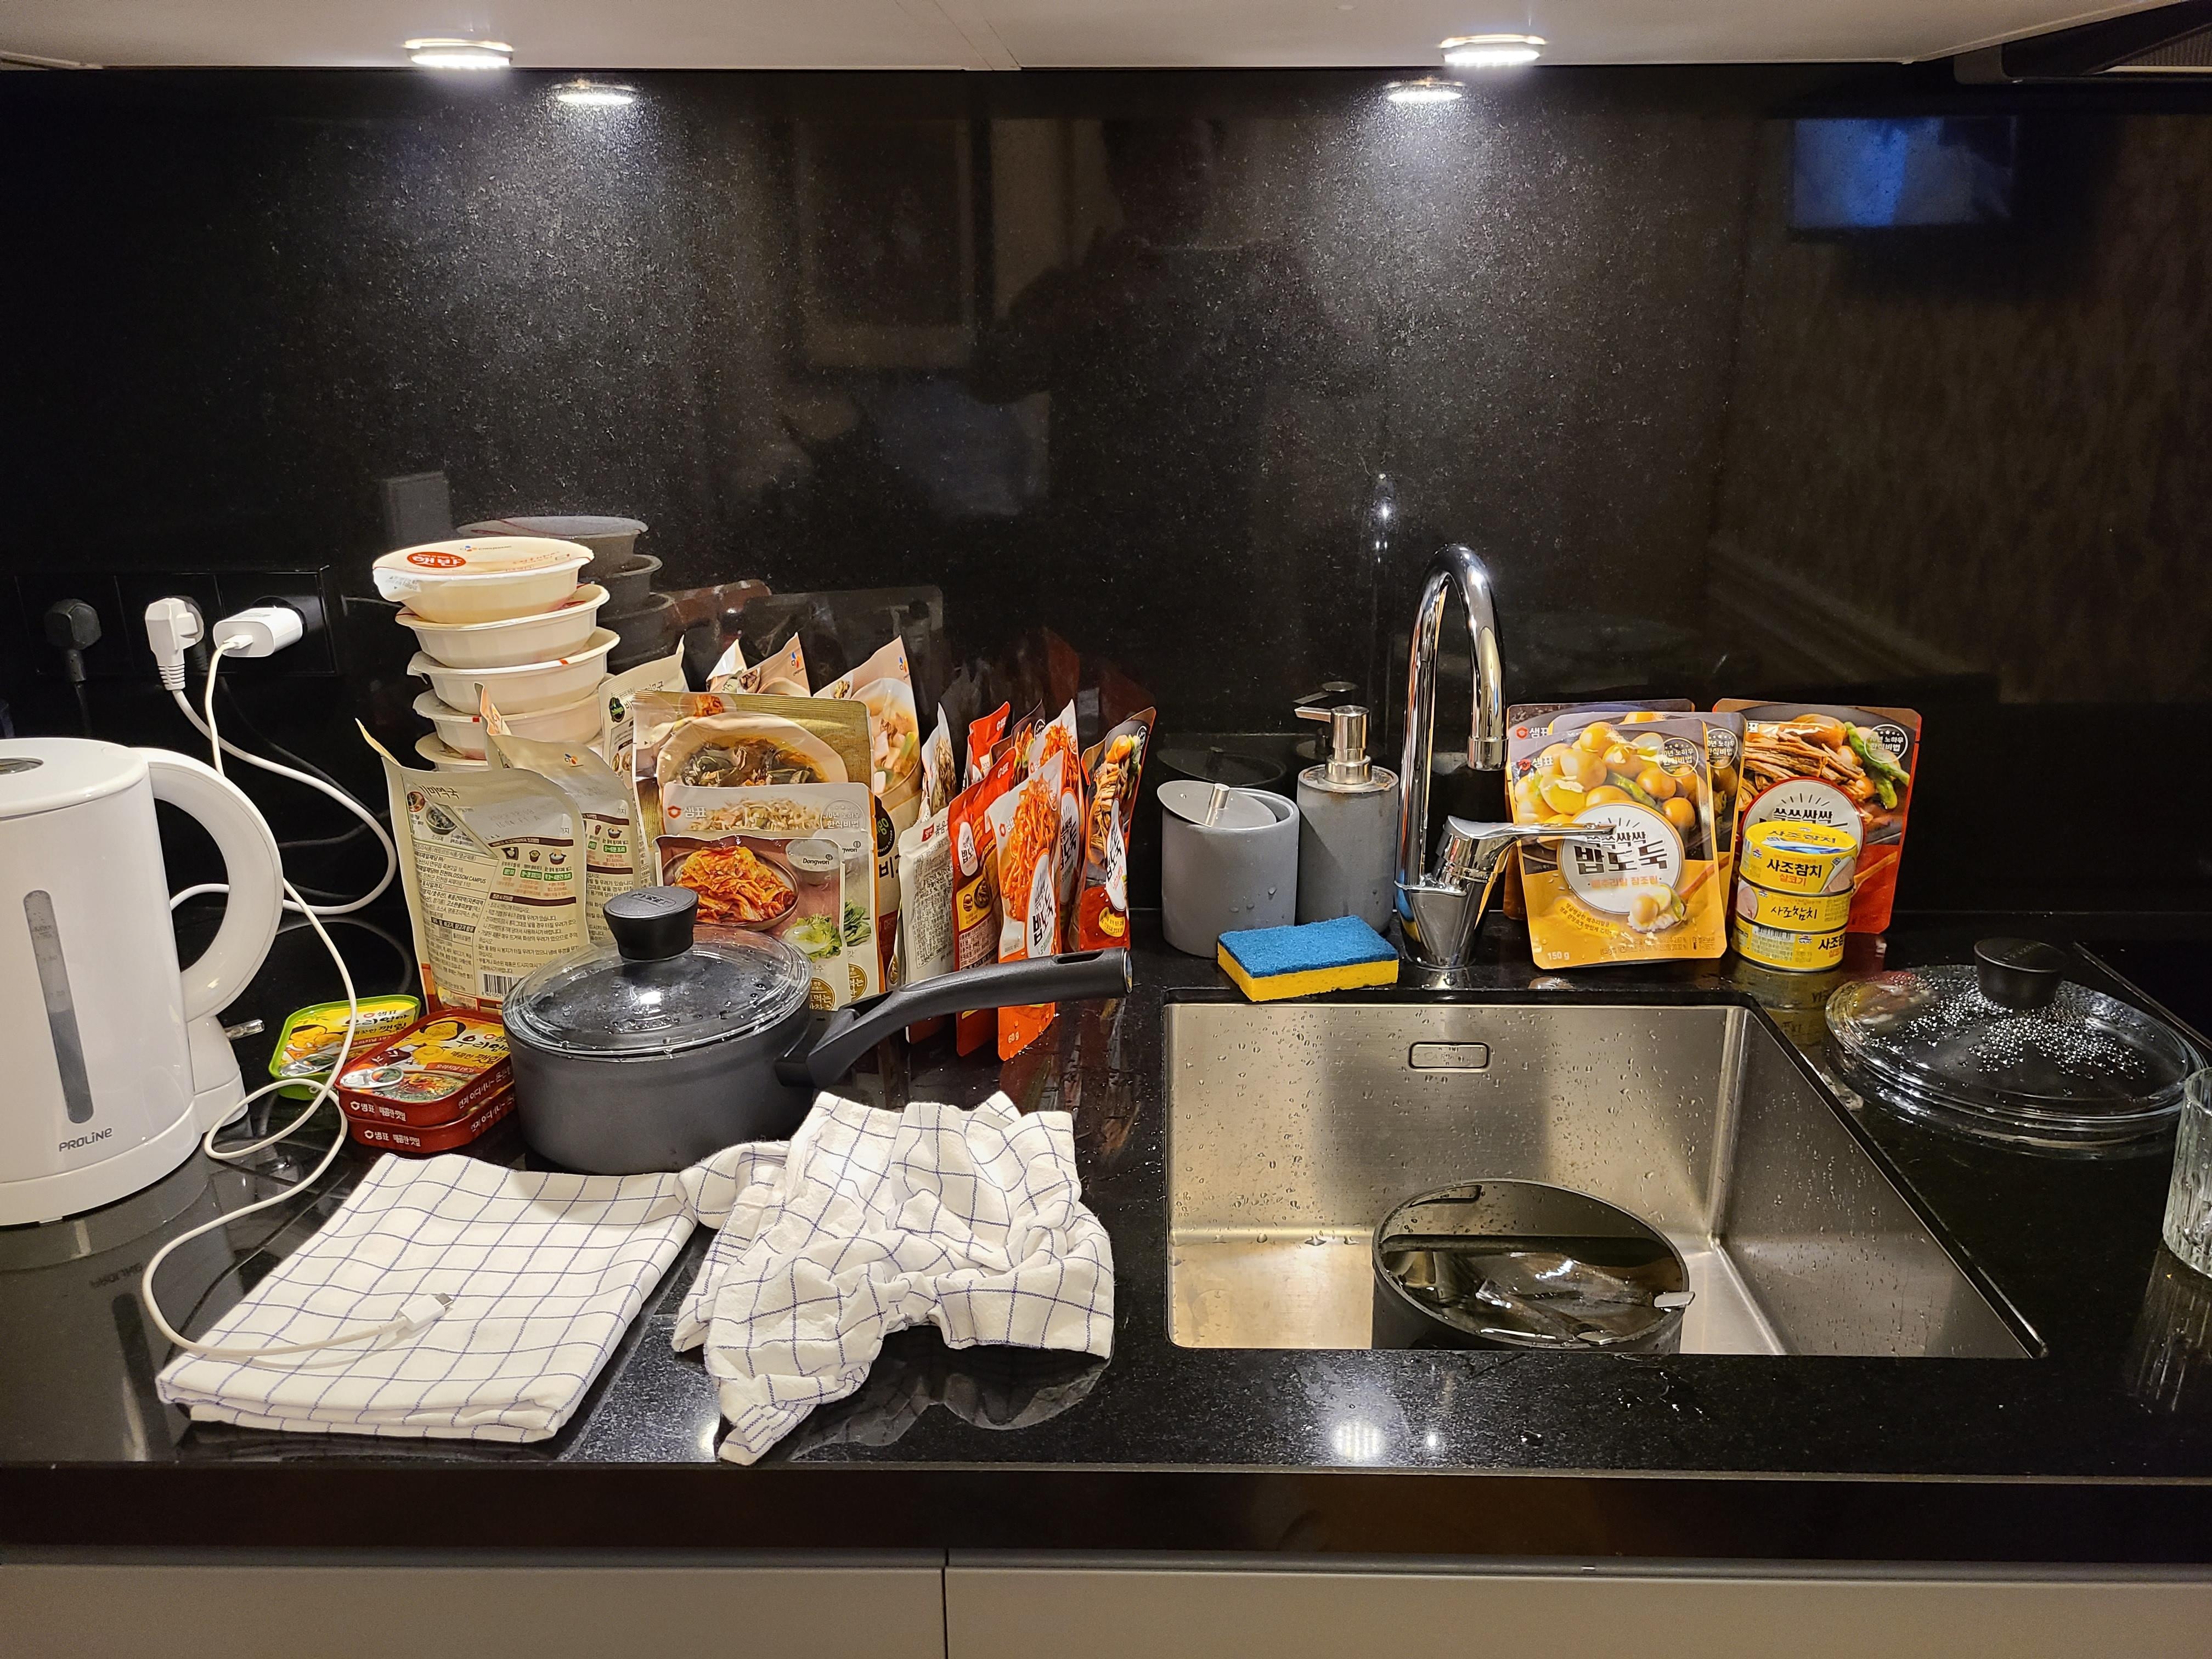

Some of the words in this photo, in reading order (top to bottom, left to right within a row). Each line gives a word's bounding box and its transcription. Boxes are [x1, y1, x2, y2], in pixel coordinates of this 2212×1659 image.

[411, 555, 462, 567] 햇반
[1746, 723, 1759, 733] 표
[1532, 756, 1554, 768] 샘표
[684, 806, 707, 819] 샘표
[827, 820, 859, 828] 한식비법
[1768, 830, 1836, 843] 사조참치
[803, 857, 830, 866] Dongwon
[1573, 840, 1668, 874] 밥도둑
[1767, 859, 1822, 878] 사조참치
[469, 874, 487, 884] CAMPUS
[1779, 873, 1807, 887] 살코기
[1770, 905, 1818, 922] 사조참치
[1547, 951, 1563, 961] 150
[1564, 952, 1570, 961] g
[1008, 1032, 1015, 1043] 60
[450, 1051, 475, 1060] 매콤한
[472, 1053, 503, 1065] 깻잎
[361, 1103, 375, 1114] 샘표
[374, 1131, 390, 1141] 샘표
